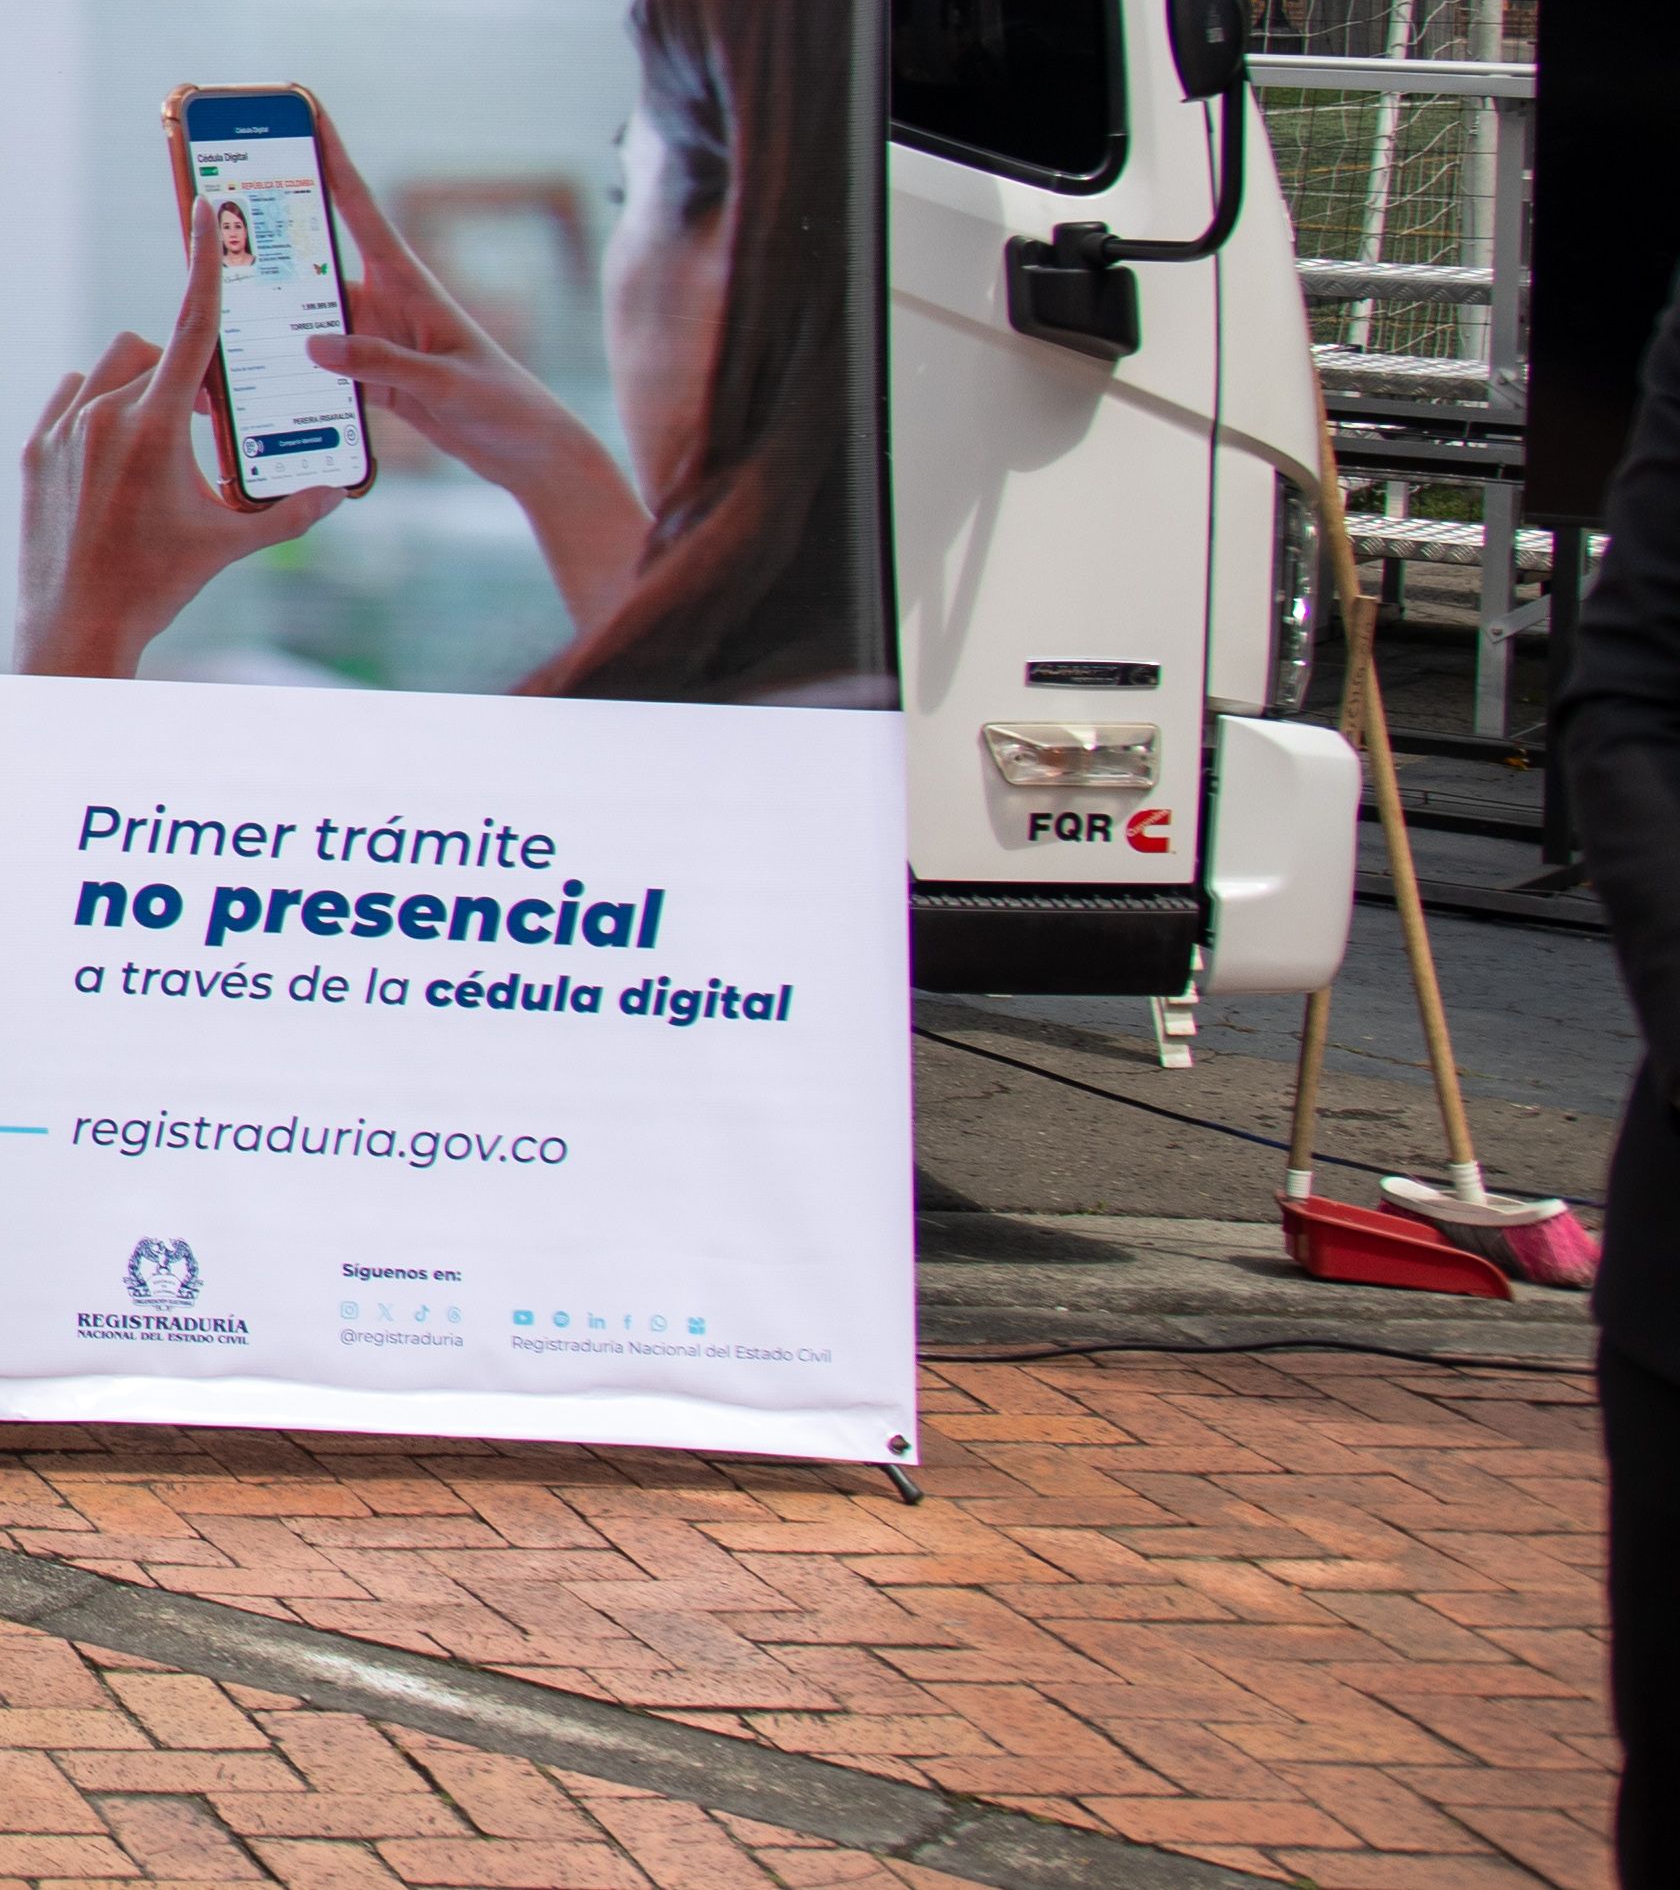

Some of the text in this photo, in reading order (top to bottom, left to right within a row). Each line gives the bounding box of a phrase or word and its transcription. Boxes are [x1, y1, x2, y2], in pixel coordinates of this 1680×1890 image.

[76, 804, 557, 870] Primer trámite
[1028, 812, 1113, 842] FQR
[73, 877, 664, 950] no presencial
[74, 959, 793, 1027] a través de la cédula digital
[72, 1110, 568, 1170] registraduria.gov.co
[342, 1263, 463, 1282] Síguenos en:
[77, 1312, 249, 1334] REGISTRADURÍA
[77, 1330, 249, 1345] NACIONAL DEL ESTADO CIVIL
[340, 1328, 464, 1348] @registraduria
[629, 1341, 701, 1359] Nacional
[706, 1343, 730, 1360] del
[735, 1346, 793, 1363] Estado
[797, 1348, 832, 1364] Civil
